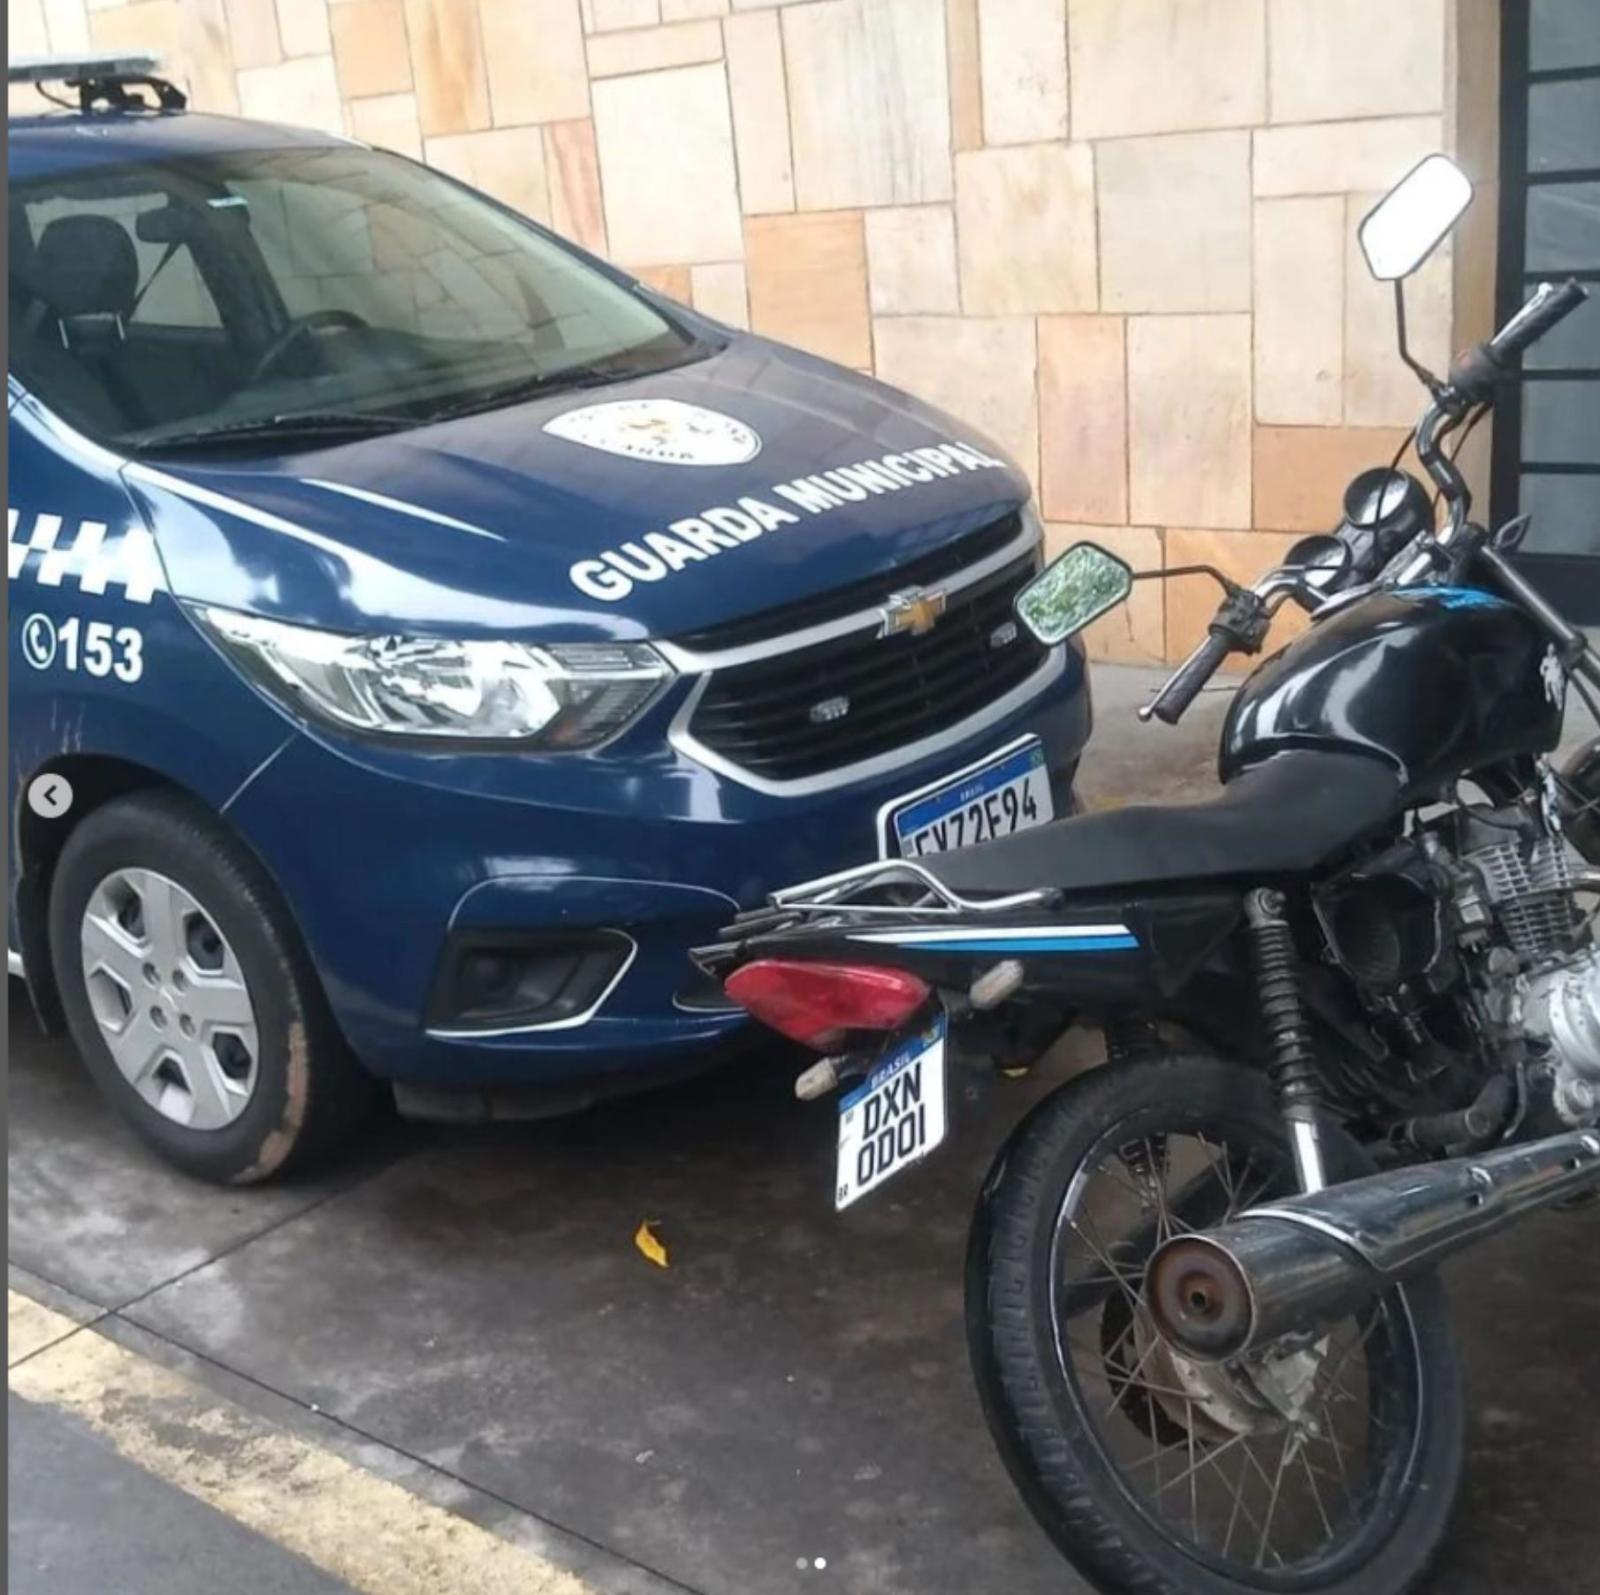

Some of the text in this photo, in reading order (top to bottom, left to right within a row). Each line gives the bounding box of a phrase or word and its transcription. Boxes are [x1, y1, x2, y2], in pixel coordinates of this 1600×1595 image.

[569, 441, 1006, 601] GUARDA MUNICIPAL
[58, 616, 143, 682] 153
[863, 1062, 921, 1140] DXN
